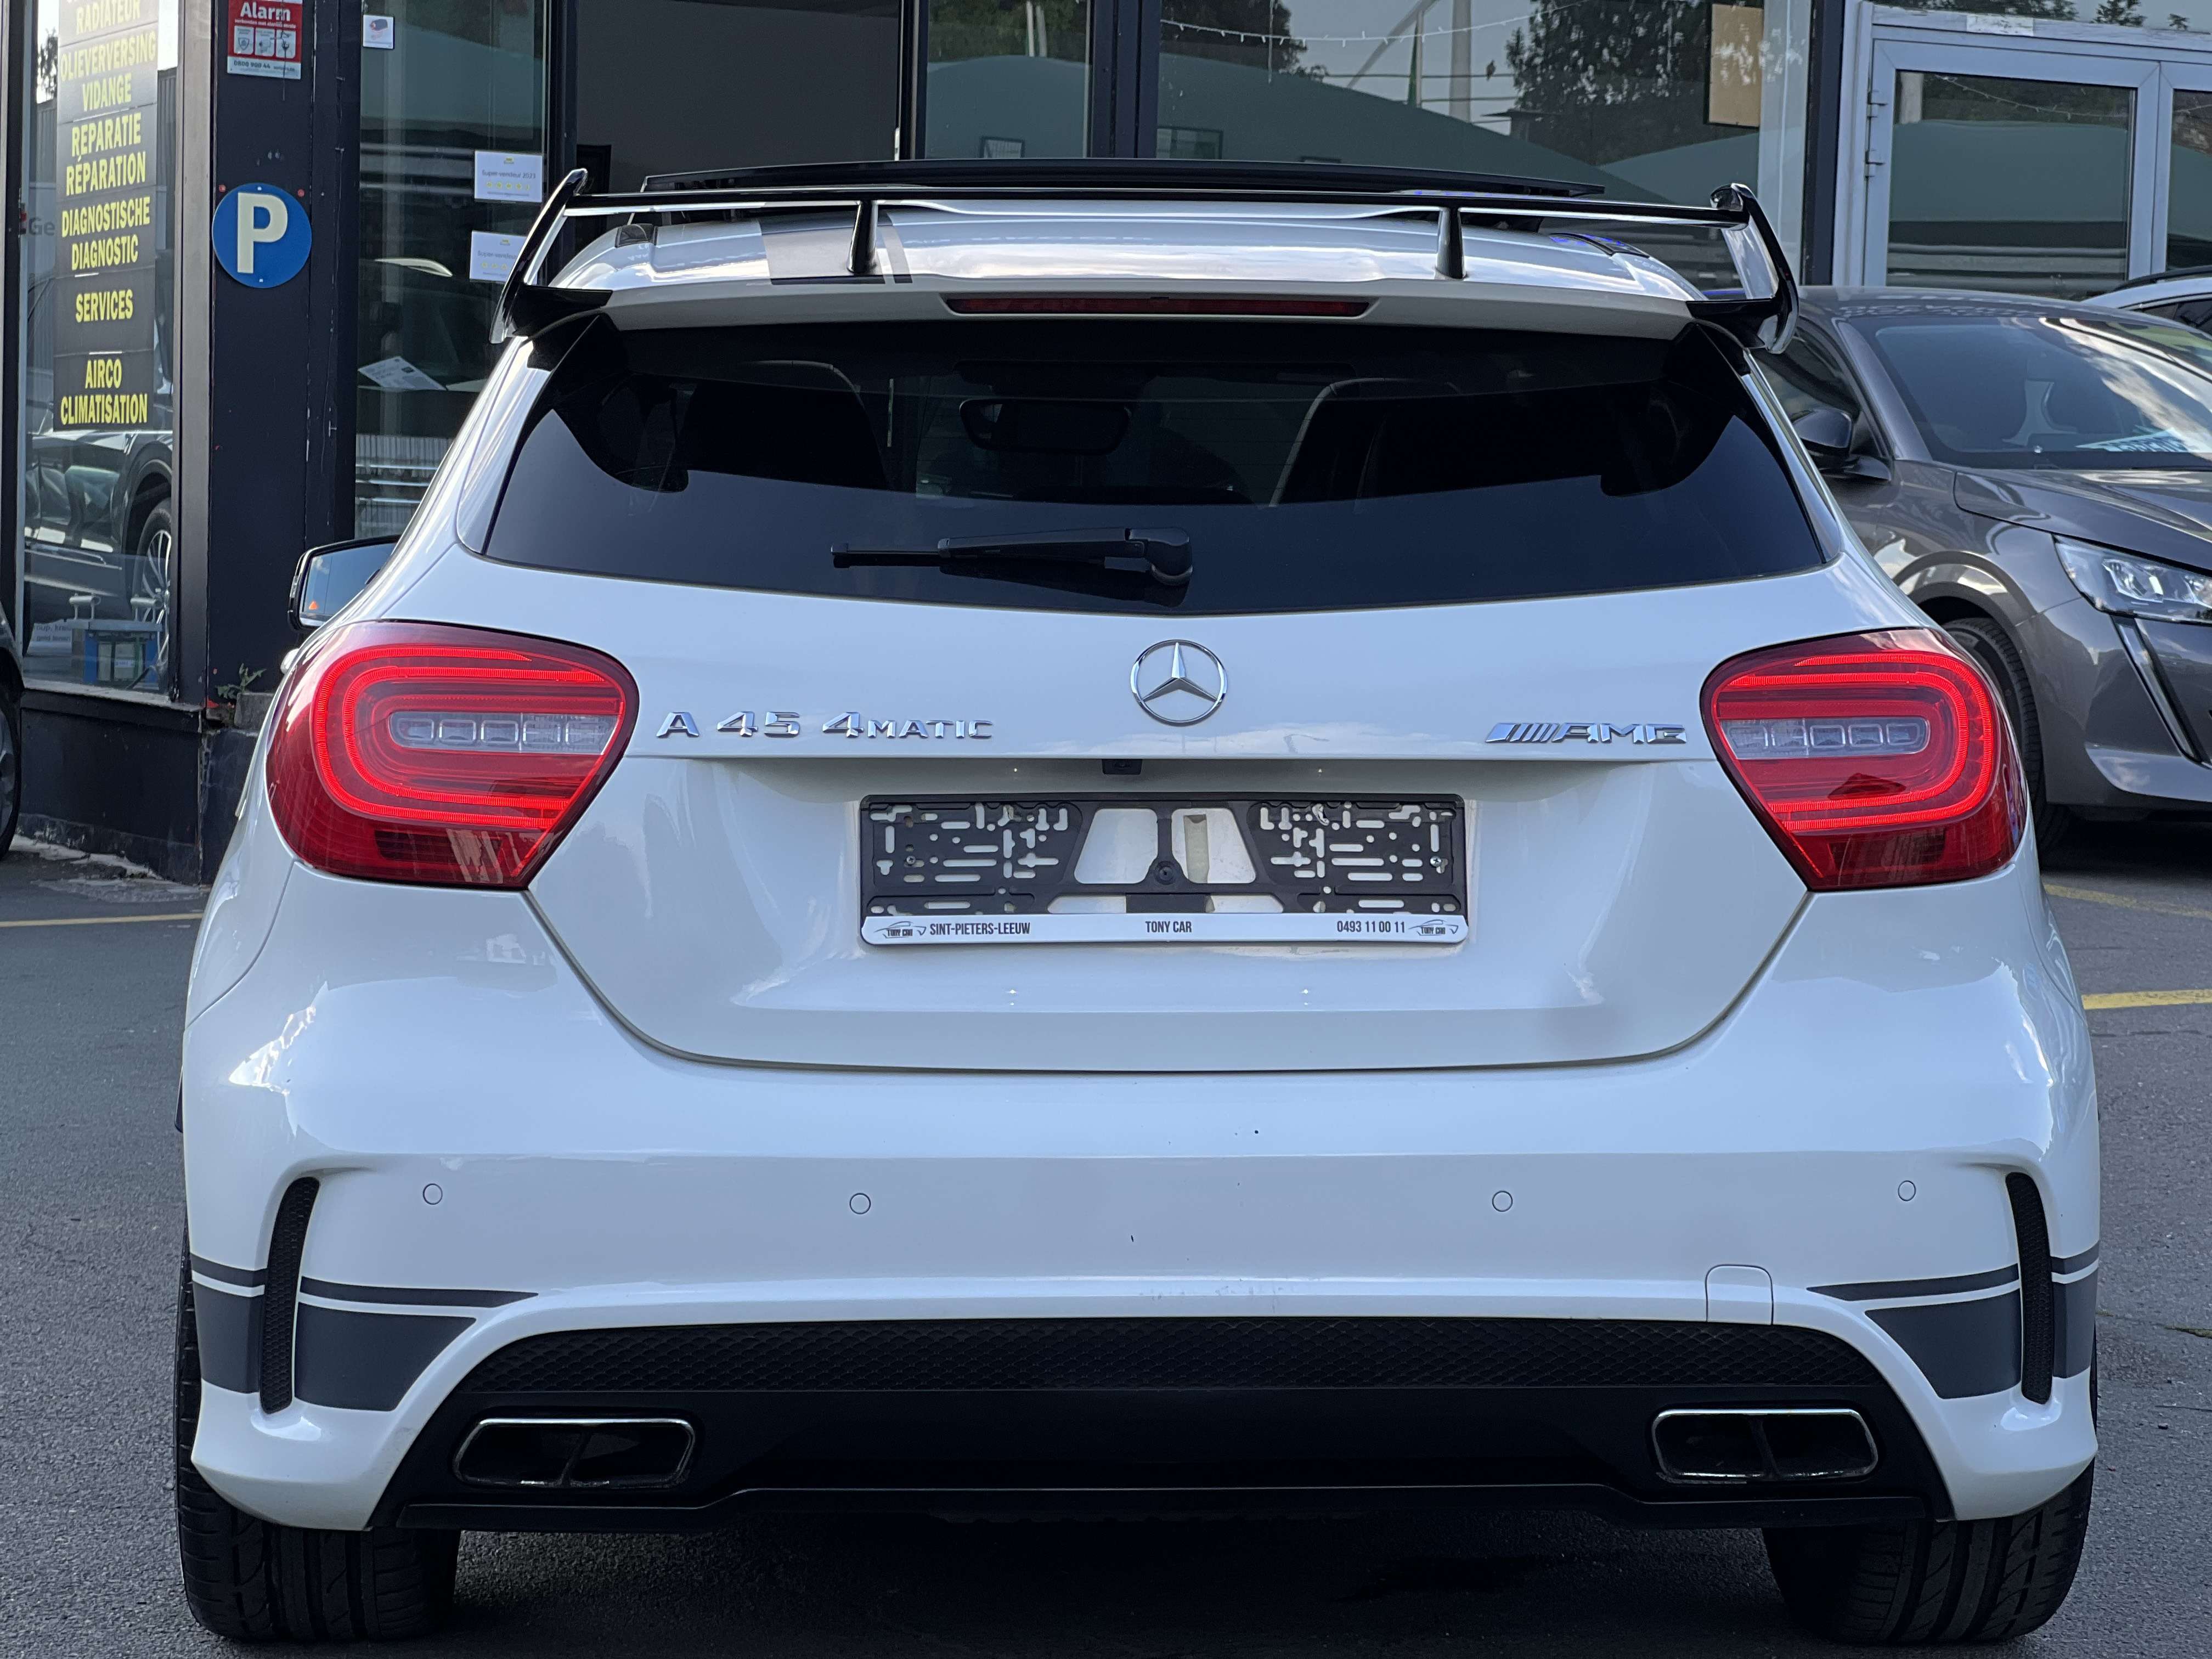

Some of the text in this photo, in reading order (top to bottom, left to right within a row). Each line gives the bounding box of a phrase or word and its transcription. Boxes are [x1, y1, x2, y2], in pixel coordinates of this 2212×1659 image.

[76, 0, 140, 35] RADIATEUR
[240, 2, 291, 21] Alarm
[60, 31, 156, 81] OLIEVERVERSING
[82, 72, 132, 111] VIDANGE
[72, 112, 142, 157] REPARATIE
[66, 151, 146, 196] RÉPARATION
[61, 196, 150, 238] DIAGNOSTISCHE
[237, 192, 288, 274] P
[72, 234, 138, 270] DIAGNOSTIC
[76, 289, 133, 323] SERVICES
[85, 358, 122, 388] AIRCO
[61, 393, 148, 425] CLIMATISATION
[656, 712, 992, 739] A 45 4MATIC
[930, 922, 1030, 935] SINT-PIETERS-LEEUW
[1145, 921, 1192, 933] TONY CAR
[1337, 921, 1405, 933] 0493 11 00 11
